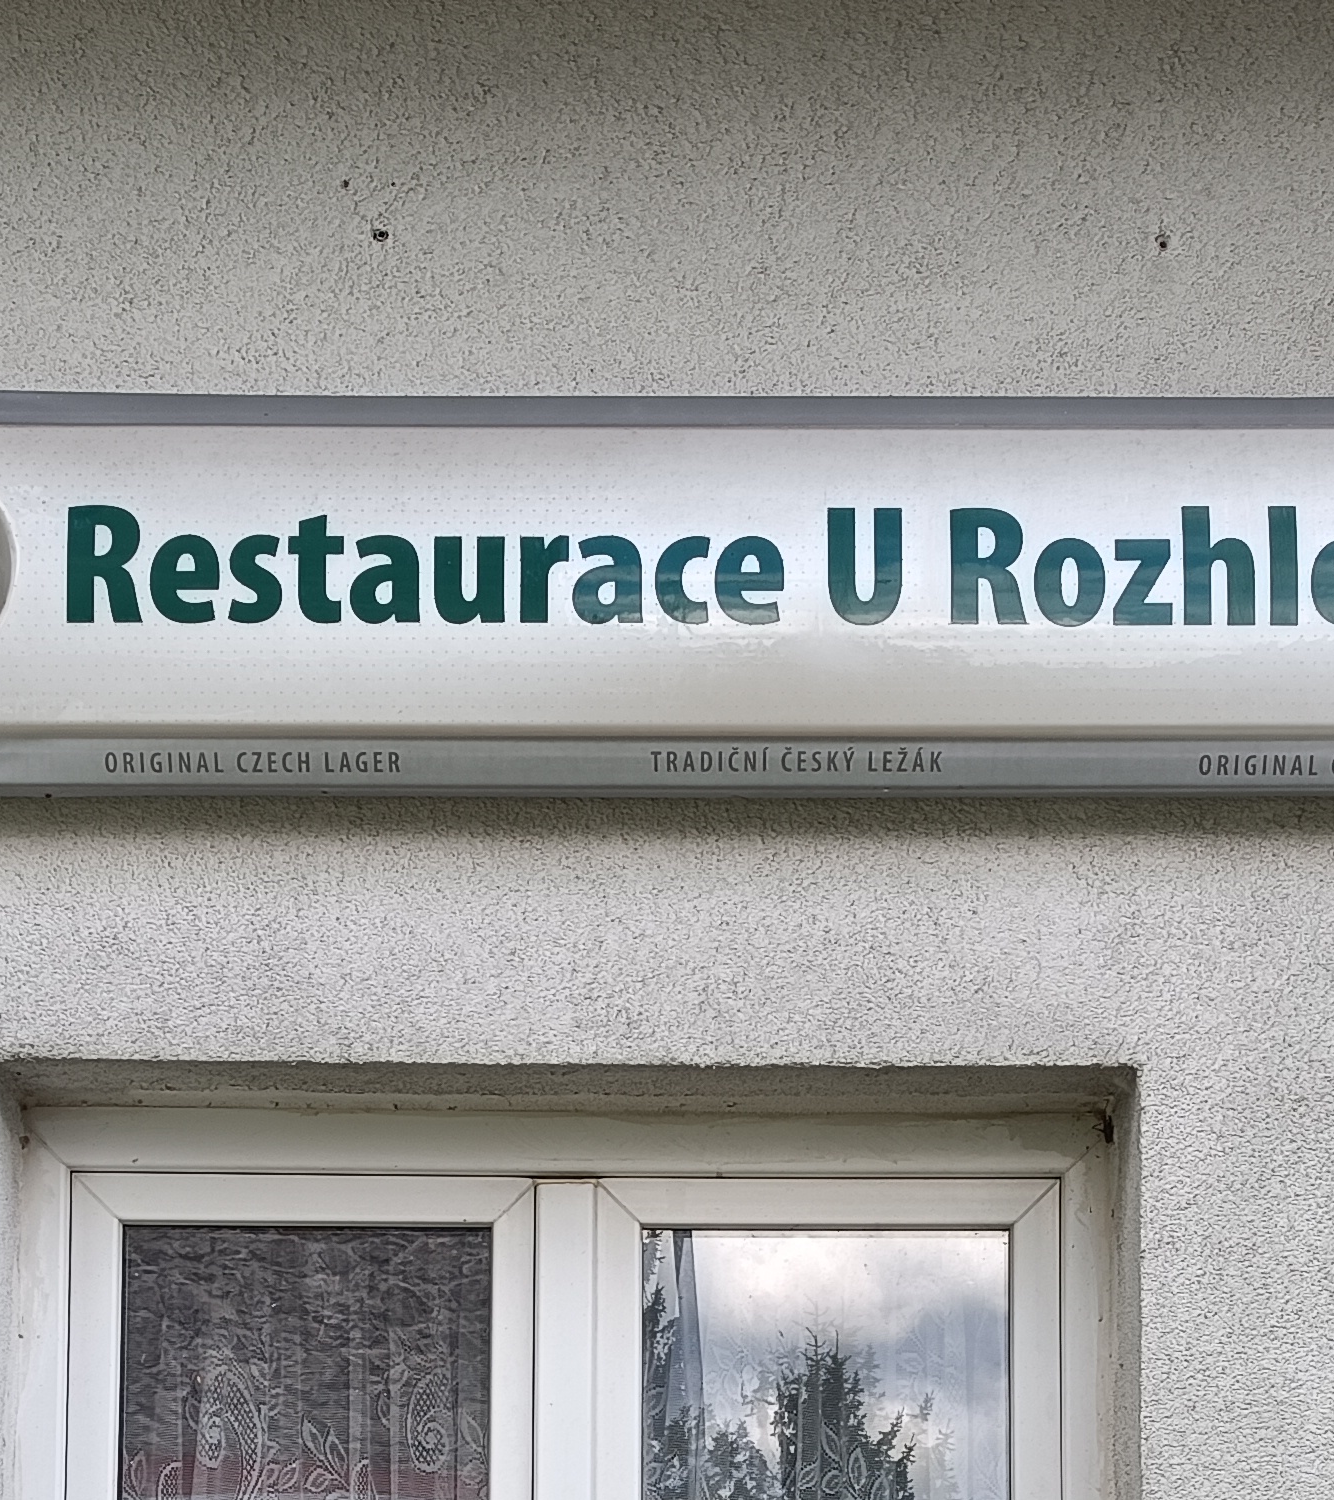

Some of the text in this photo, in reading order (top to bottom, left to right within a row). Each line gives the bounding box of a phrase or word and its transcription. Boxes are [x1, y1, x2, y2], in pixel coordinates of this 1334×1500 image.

[66, 504, 785, 624] Restaurace
[826, 507, 903, 625] U
[104, 751, 401, 773] ORIGINAL CZECH LAGER
[650, 746, 943, 773] TRADIČNÍ ČESKÝ LEŽÁK
[1199, 754, 1318, 776] ORIGINAL
